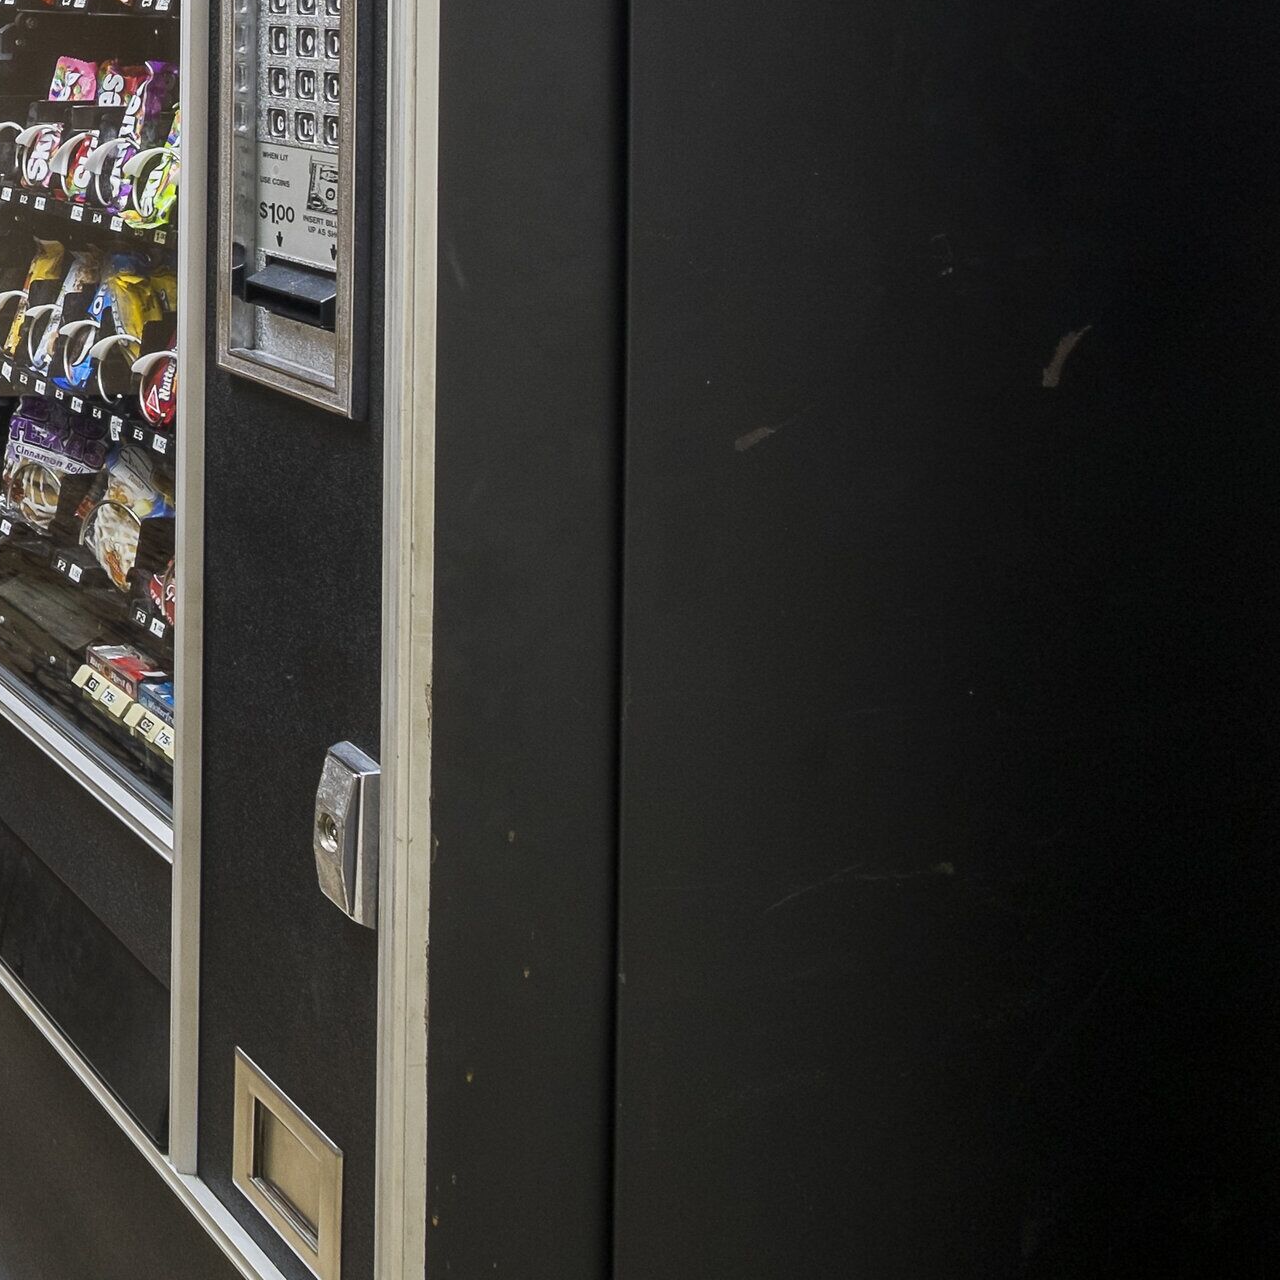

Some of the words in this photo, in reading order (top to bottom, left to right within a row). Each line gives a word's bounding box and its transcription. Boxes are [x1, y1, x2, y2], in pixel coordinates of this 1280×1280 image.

[262, 151, 278, 160] WHEN
[92, 213, 102, 224] D4
[260, 201, 295, 225] $1.00
[303, 215, 324, 225] INSERT
[19, 374, 28, 384] E2
[55, 389, 64, 400] E3
[92, 408, 102, 419] E4
[133, 428, 143, 441] E5
[16, 445, 63, 467] Cinnamon
[66, 463, 85, 474] Roll
[57, 560, 66, 571] F2
[136, 611, 146, 623] F3
[140, 719, 154, 733] G2
